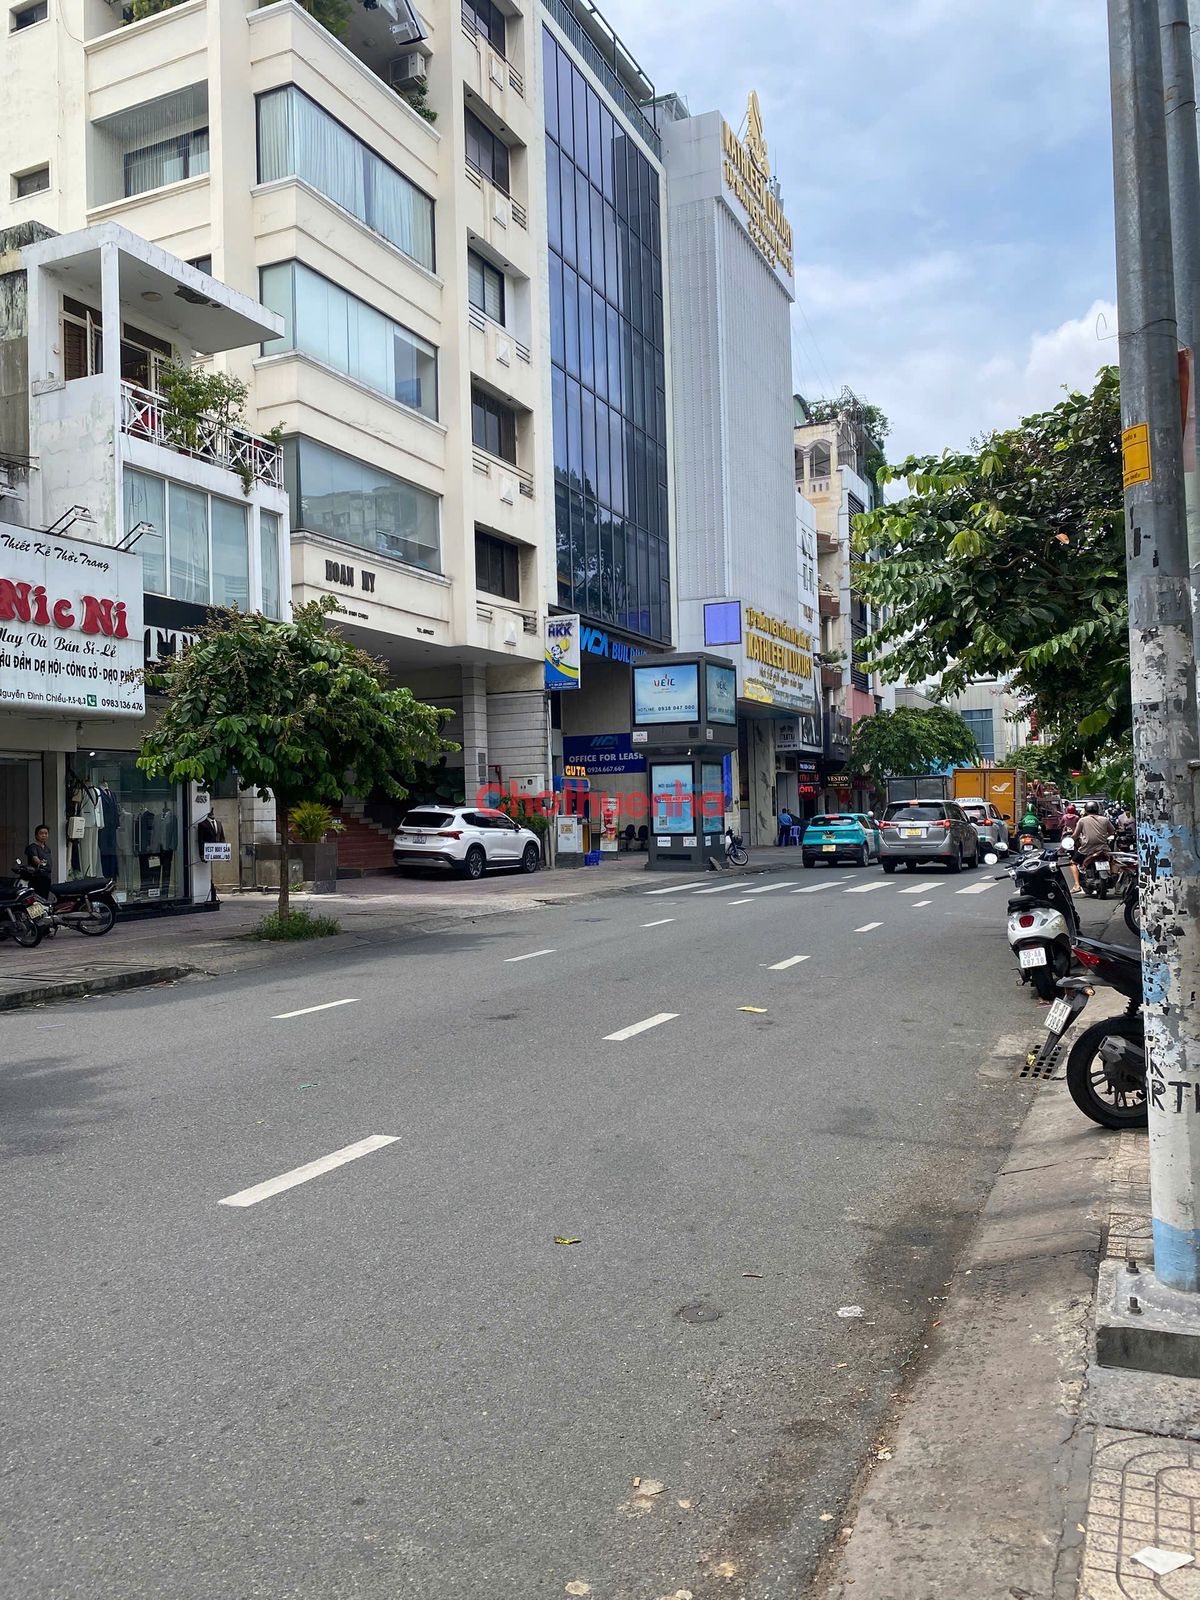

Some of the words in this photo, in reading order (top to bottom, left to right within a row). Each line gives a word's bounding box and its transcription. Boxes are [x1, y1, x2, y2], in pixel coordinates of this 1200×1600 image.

[1, 533, 30, 552] Thiết
[80, 553, 109, 572] Trang
[548, 626, 573, 638] HKK
[54, 636, 80, 653] Bán
[34, 659, 46, 676] DẠ
[569, 754, 597, 763] OFFICE
[600, 753, 617, 761] FOR
[619, 752, 644, 761] LEASE
[565, 765, 586, 776] GUTA
